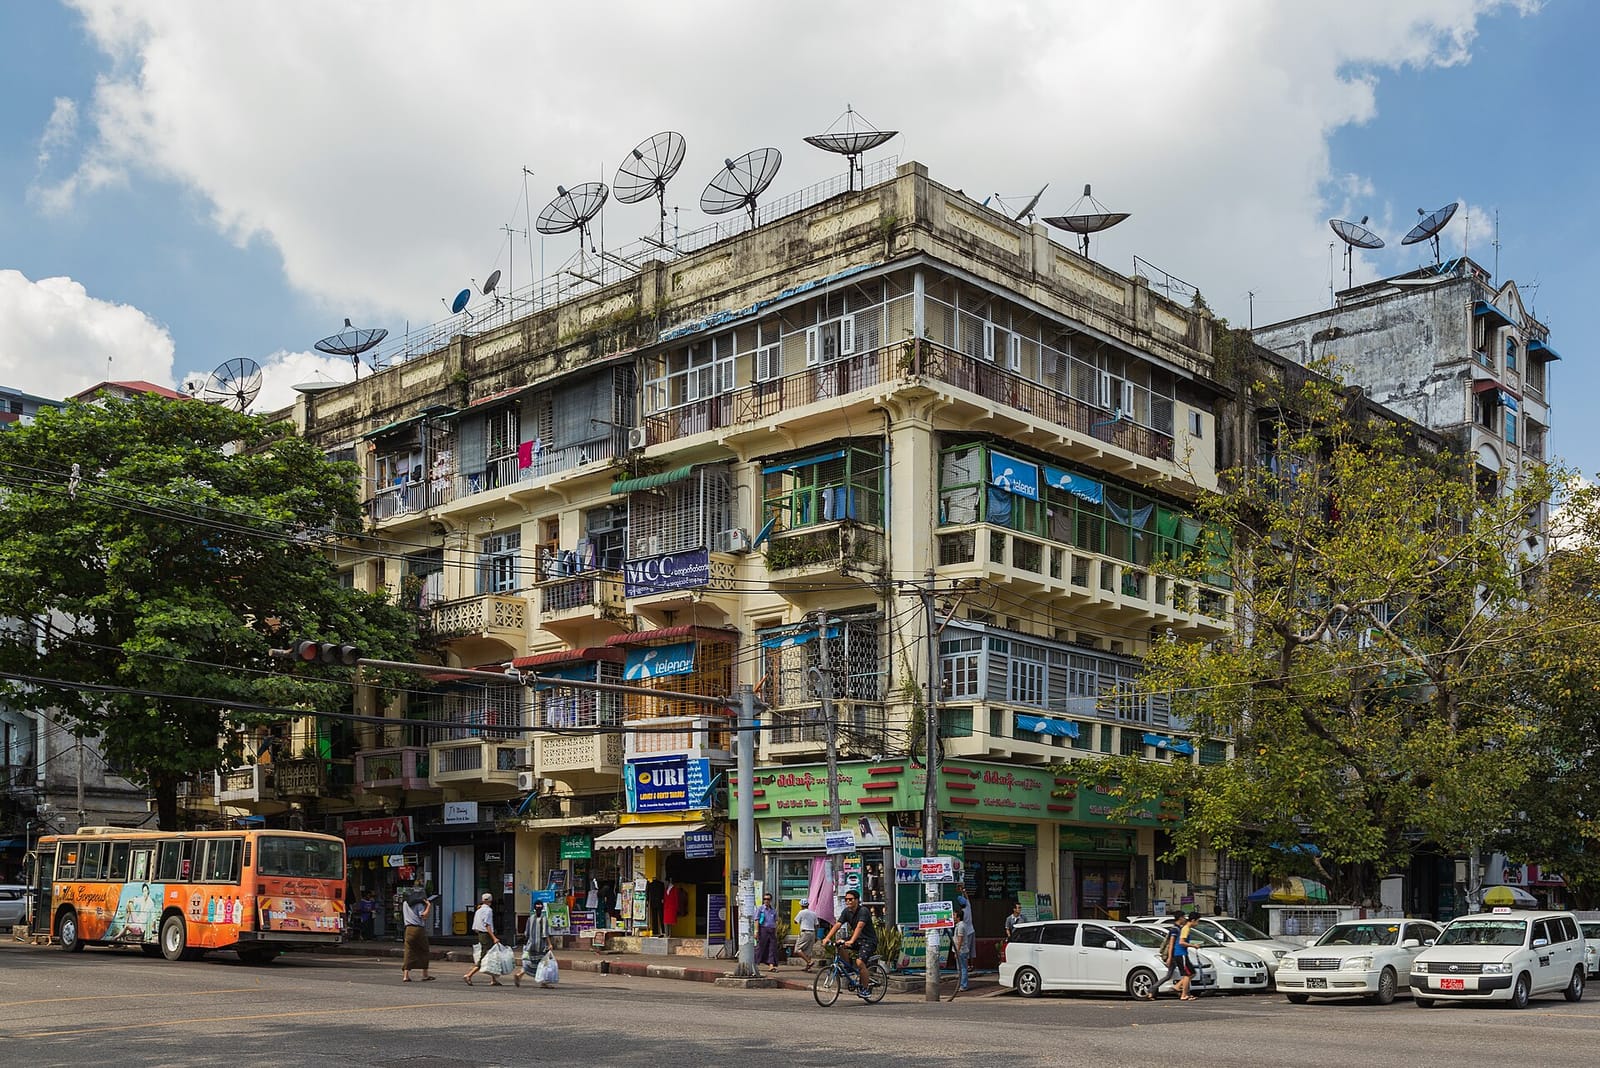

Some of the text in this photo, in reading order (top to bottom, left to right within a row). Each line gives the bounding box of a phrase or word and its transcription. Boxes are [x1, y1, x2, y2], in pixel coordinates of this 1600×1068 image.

[1013, 480, 1036, 497] telenor
[626, 556, 674, 584] MCC
[655, 659, 691, 674] telenor
[652, 768, 685, 787] URI
